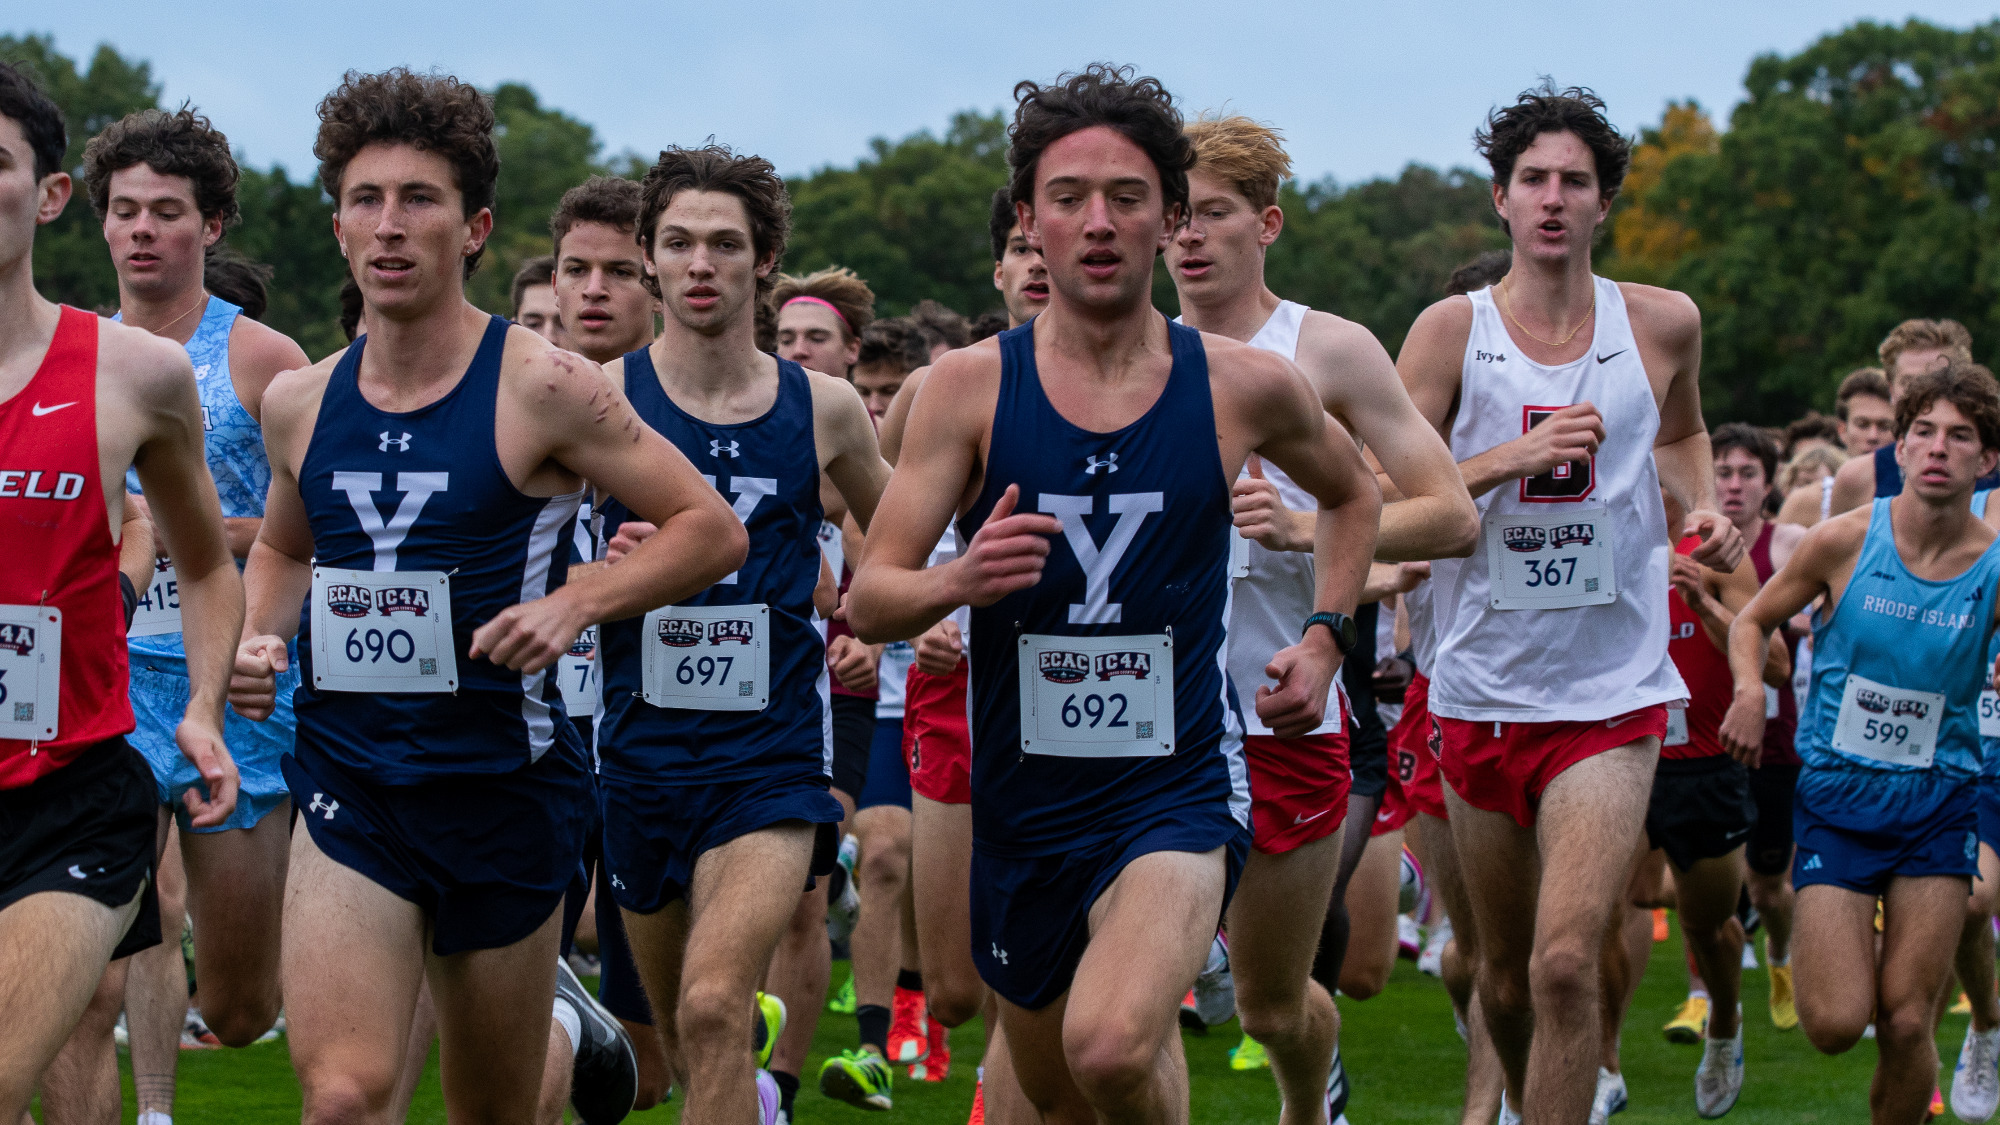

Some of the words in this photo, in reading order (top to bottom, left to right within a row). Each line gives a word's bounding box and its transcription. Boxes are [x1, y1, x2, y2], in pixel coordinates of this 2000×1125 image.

[1476, 350, 1496, 363] Ivy
[331, 471, 449, 572] Y
[1503, 527, 1546, 542] ECAC
[1550, 524, 1593, 543] IC4A
[1037, 491, 1164, 624] Y
[1524, 557, 1578, 587] 367
[138, 581, 180, 611] 415
[327, 585, 371, 606] ECAC
[376, 588, 428, 608] IC4A
[1862, 595, 1918, 621] RHODE
[1921, 608, 1976, 630] ISLAND
[658, 620, 703, 636] ECAC
[708, 621, 752, 639] IC4A
[345, 627, 415, 664] 690
[675, 655, 734, 686] 697
[1040, 652, 1088, 670] ECAC
[1095, 653, 1150, 673] IC4A
[1061, 693, 1129, 729] 692
[1857, 688, 1890, 708] ECAC
[1863, 718, 1909, 746] 599
[1398, 747, 1417, 784] B
